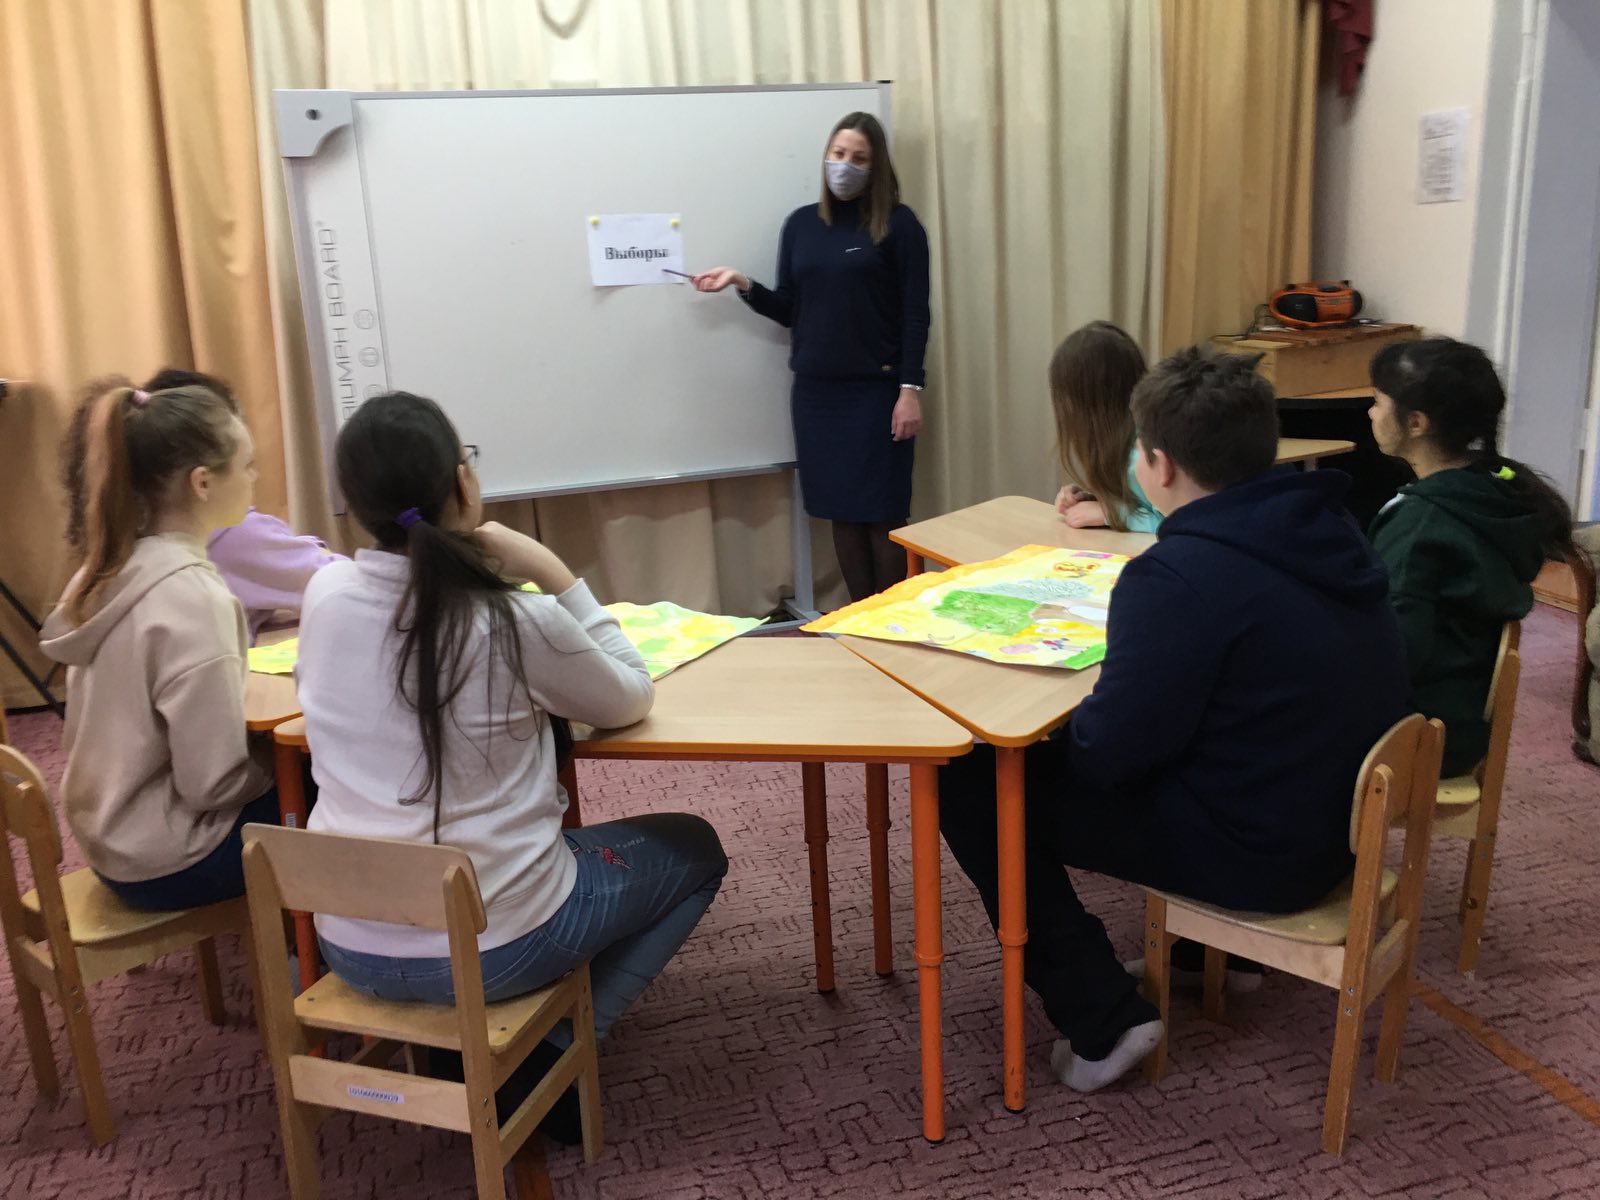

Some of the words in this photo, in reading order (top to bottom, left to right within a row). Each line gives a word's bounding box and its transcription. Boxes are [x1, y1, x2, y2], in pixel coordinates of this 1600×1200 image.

[318, 228, 345, 317] BOARD
[604, 246, 669, 262] Выборы
[331, 327, 358, 421] RIUMPH
